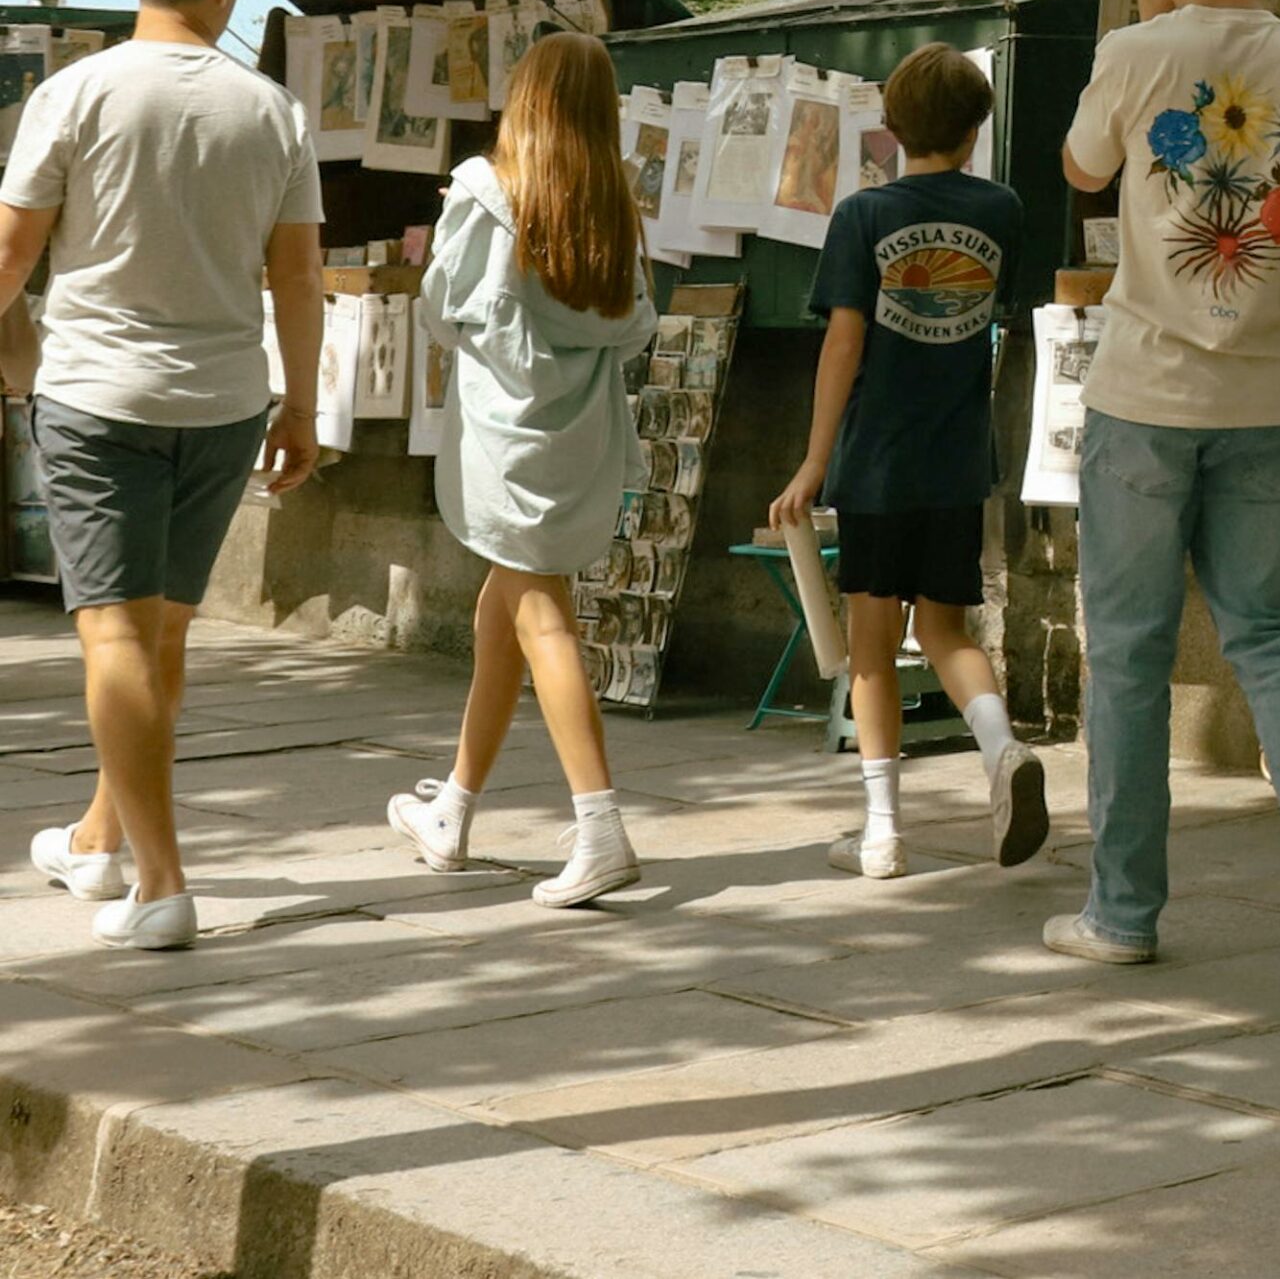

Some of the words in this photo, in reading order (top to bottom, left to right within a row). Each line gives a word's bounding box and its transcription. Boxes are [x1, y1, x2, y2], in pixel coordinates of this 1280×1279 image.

[878, 228, 946, 261] VISSLA
[951, 230, 1001, 263] SURF
[882, 307, 909, 330] THE
[955, 312, 989, 336] SEAS
[1209, 305, 1240, 321] Obey
